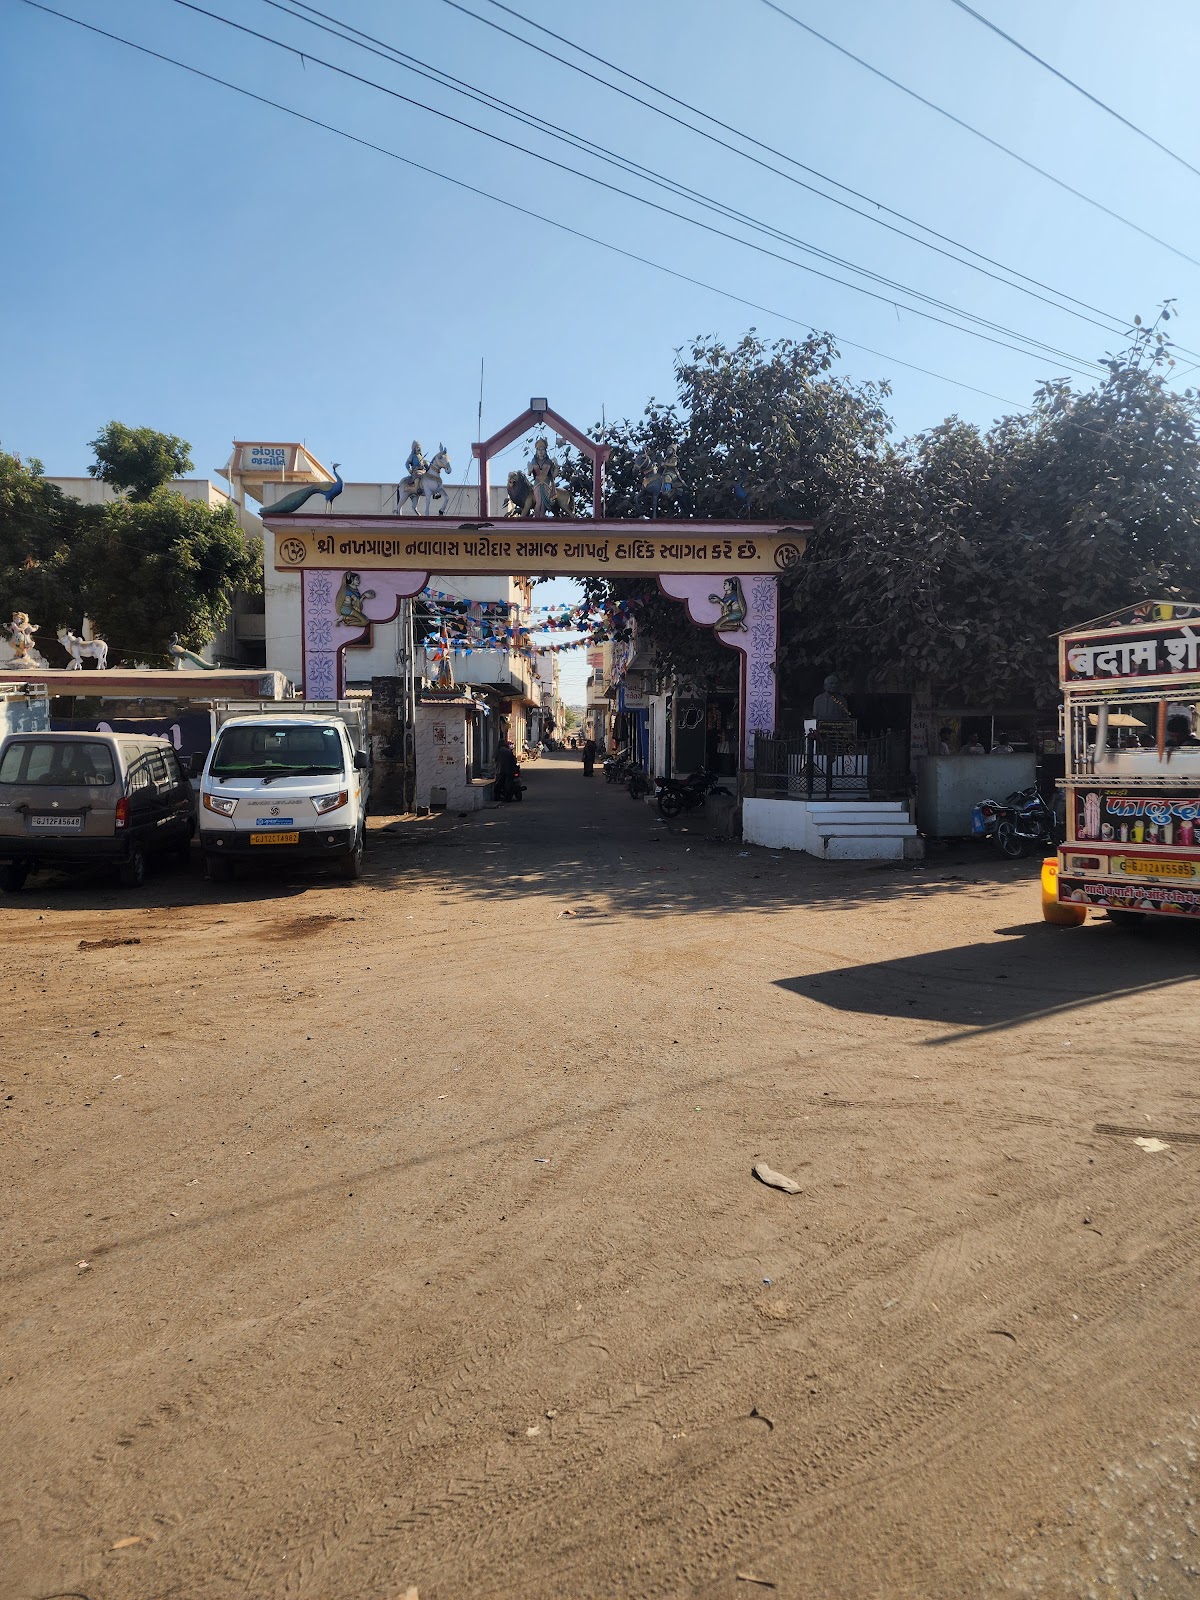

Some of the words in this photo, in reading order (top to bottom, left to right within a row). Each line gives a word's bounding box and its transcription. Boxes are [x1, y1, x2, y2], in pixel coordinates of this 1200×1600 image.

[252, 446, 285, 456] મંગલ
[317, 535, 335, 554] શ્રી
[339, 539, 400, 557] નખત્રાણા
[405, 540, 459, 556] નવાવાસ
[463, 537, 511, 557] પાટીદાર
[515, 541, 558, 557] સમાજ
[563, 539, 610, 562] આપનું
[659, 543, 707, 560] સ્વાગત
[711, 540, 732, 560] કરે
[1067, 639, 1158, 676] बदाम
[255, 834, 297, 843] GJ12CT4982
[1131, 861, 1190, 876] GJ12AV5585
